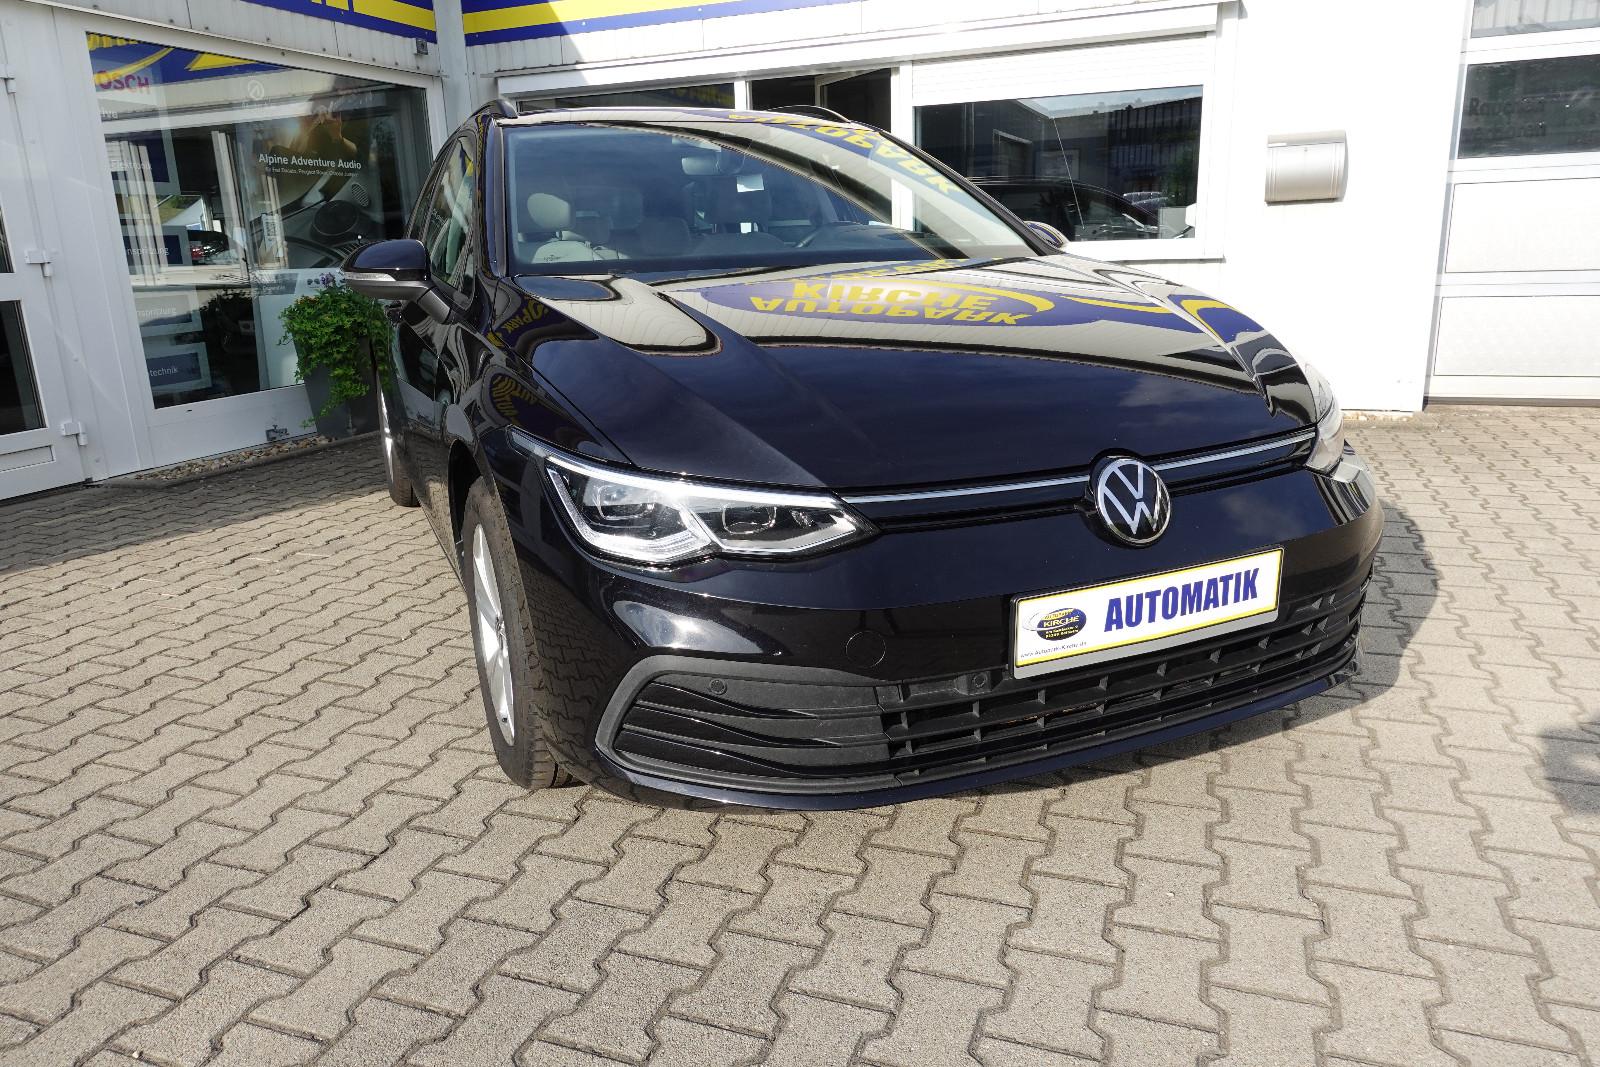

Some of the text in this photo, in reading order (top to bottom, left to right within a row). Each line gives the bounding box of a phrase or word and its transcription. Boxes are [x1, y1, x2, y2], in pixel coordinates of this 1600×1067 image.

[258, 153, 362, 170] Alpine Adventure Audio
[1104, 568, 1260, 632] AUTOMATIK
[1043, 615, 1080, 628] KIRCHE
